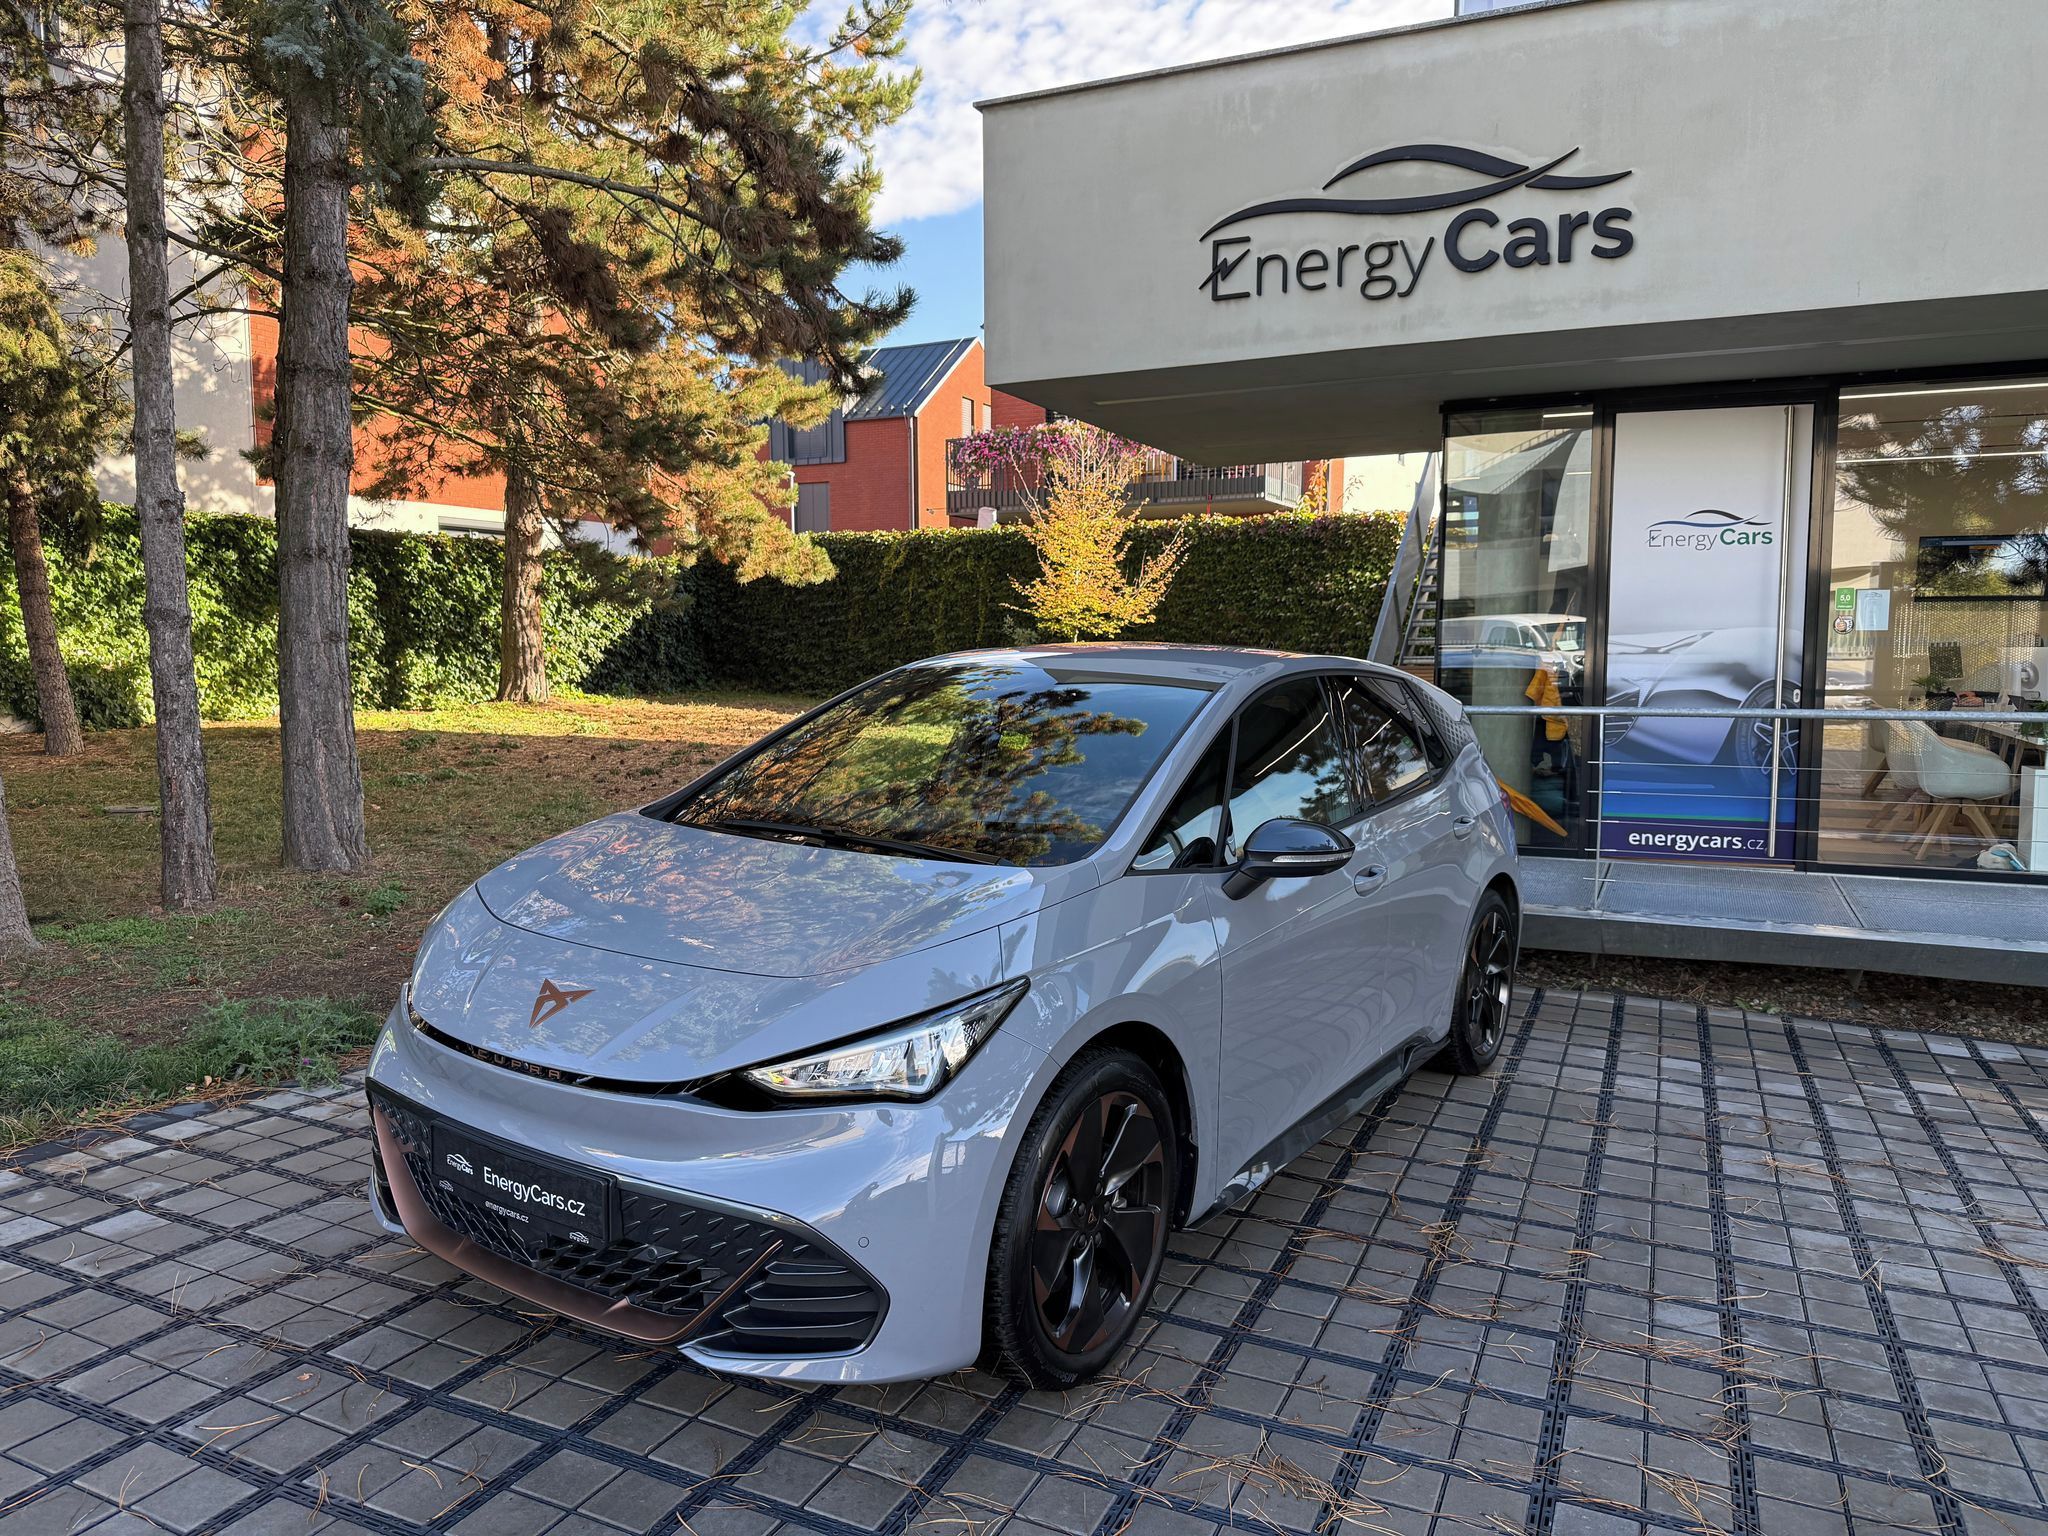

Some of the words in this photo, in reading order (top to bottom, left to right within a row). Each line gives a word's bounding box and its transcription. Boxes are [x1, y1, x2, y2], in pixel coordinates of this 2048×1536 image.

[1203, 207, 1635, 301] EnergyCars
[1647, 528, 1773, 551] EnergyCars
[1628, 832, 1764, 851] energycars.cz
[483, 1166, 586, 1217] EnergyCars.cz
[485, 1200, 530, 1224] energycars.cz
